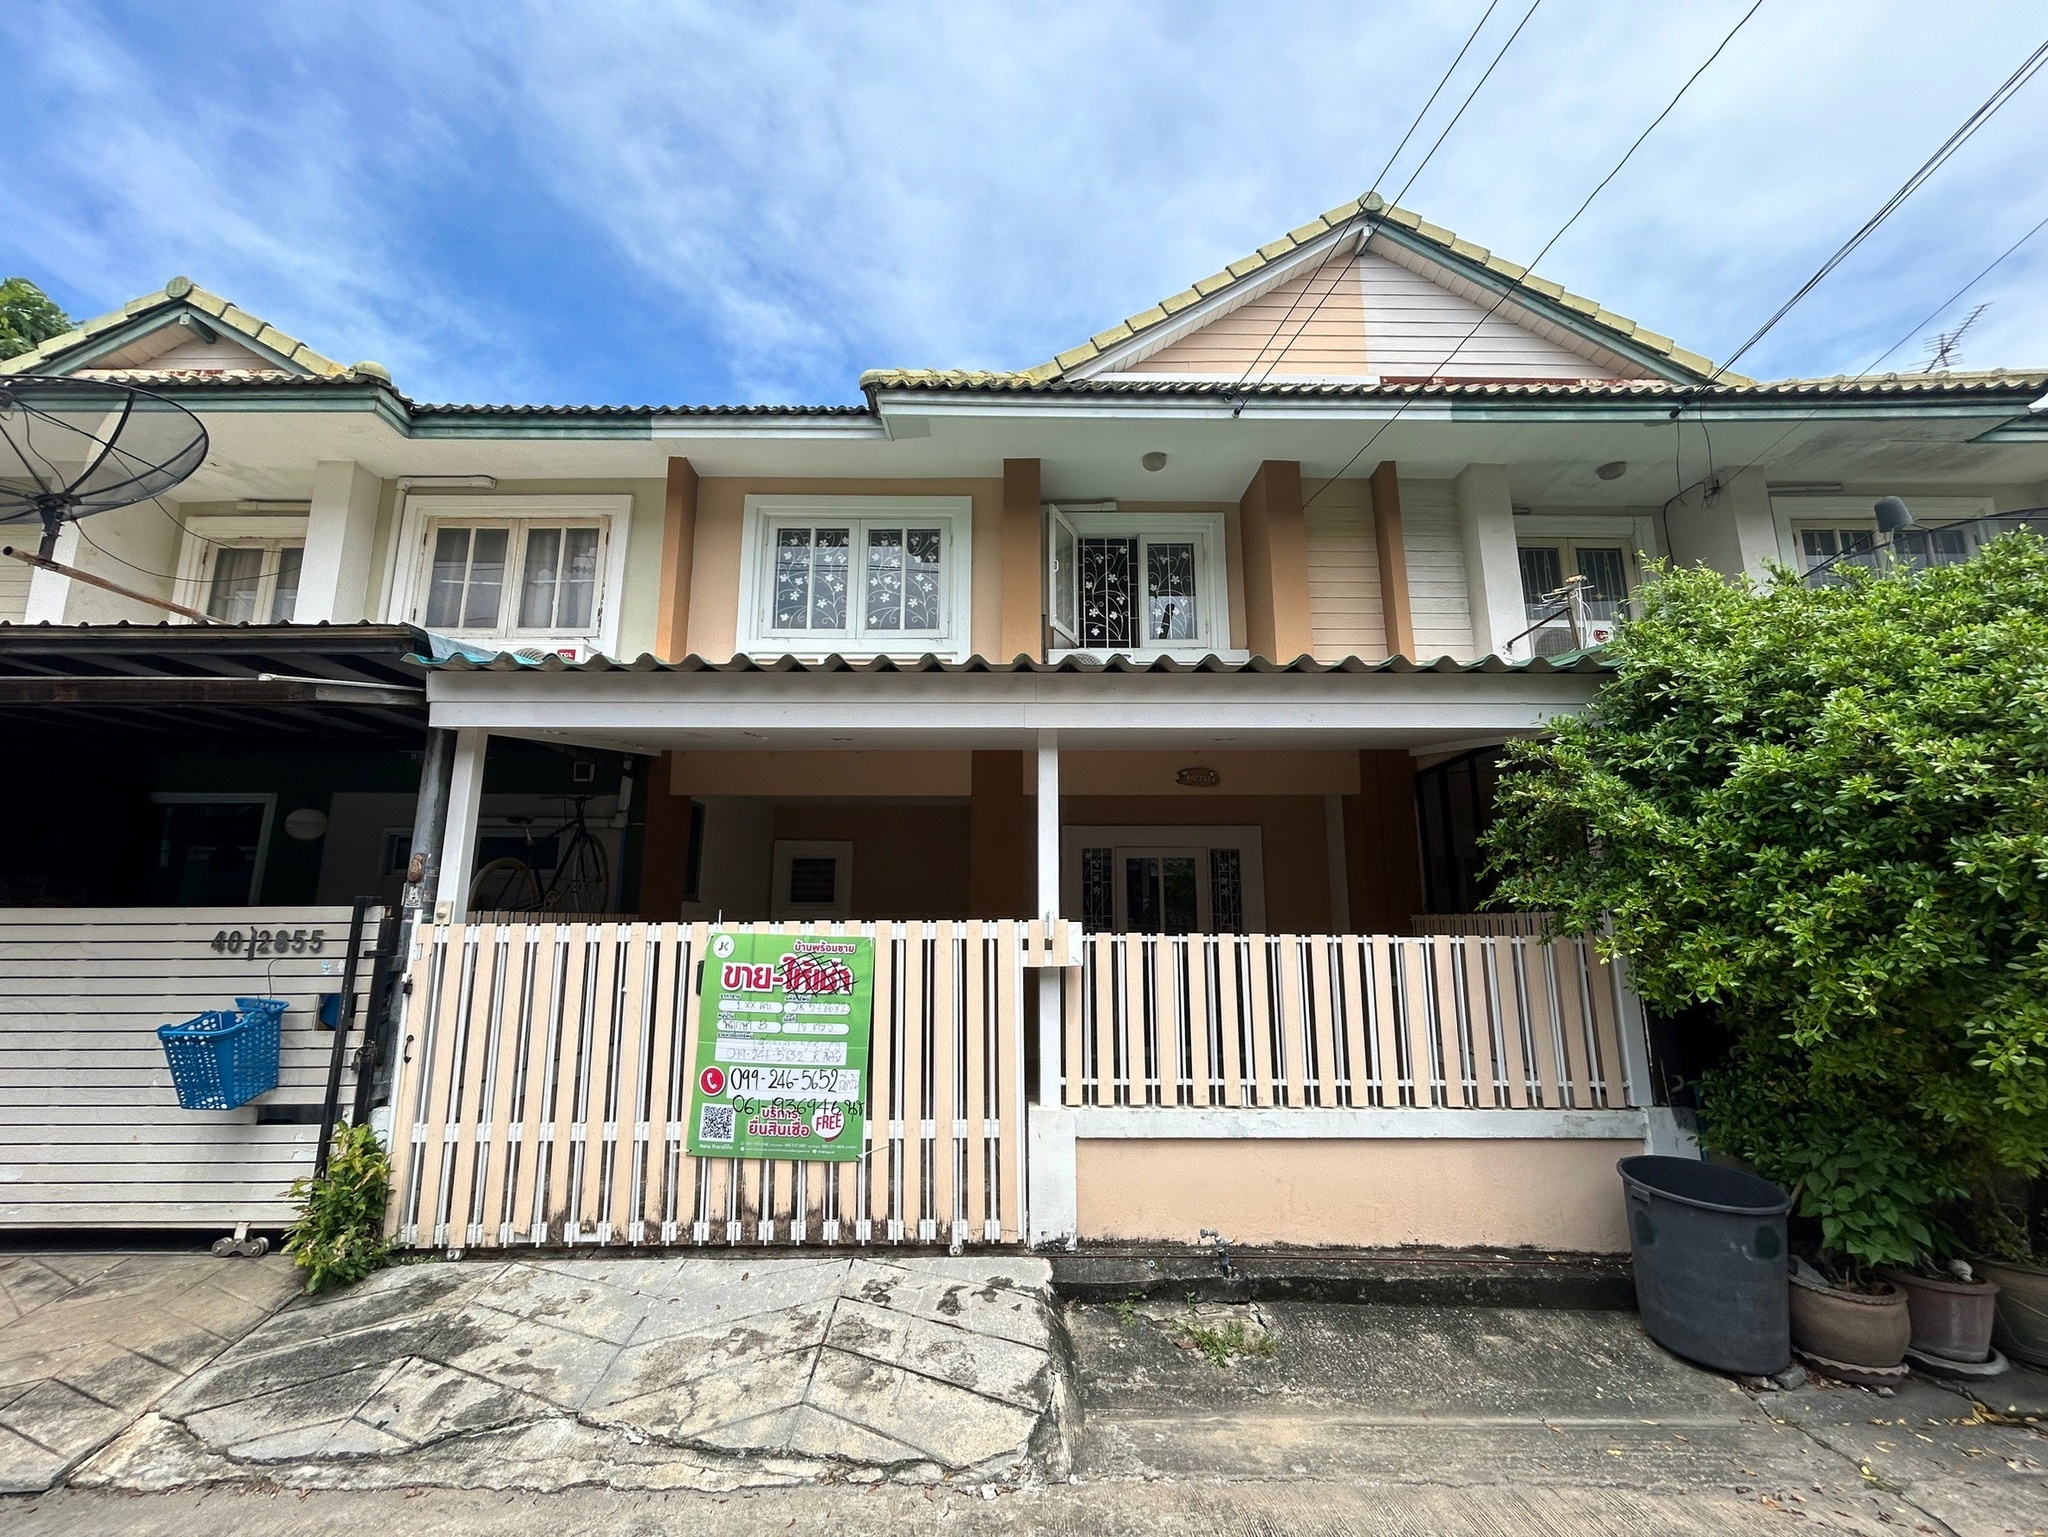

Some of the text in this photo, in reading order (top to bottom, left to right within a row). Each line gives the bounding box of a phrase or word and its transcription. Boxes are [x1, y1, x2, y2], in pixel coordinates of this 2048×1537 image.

[731, 1067, 839, 1093] 099-246-5652
[749, 1117, 810, 1136] ยื่นสินเชื่อ
[816, 1114, 842, 1131] FREE
